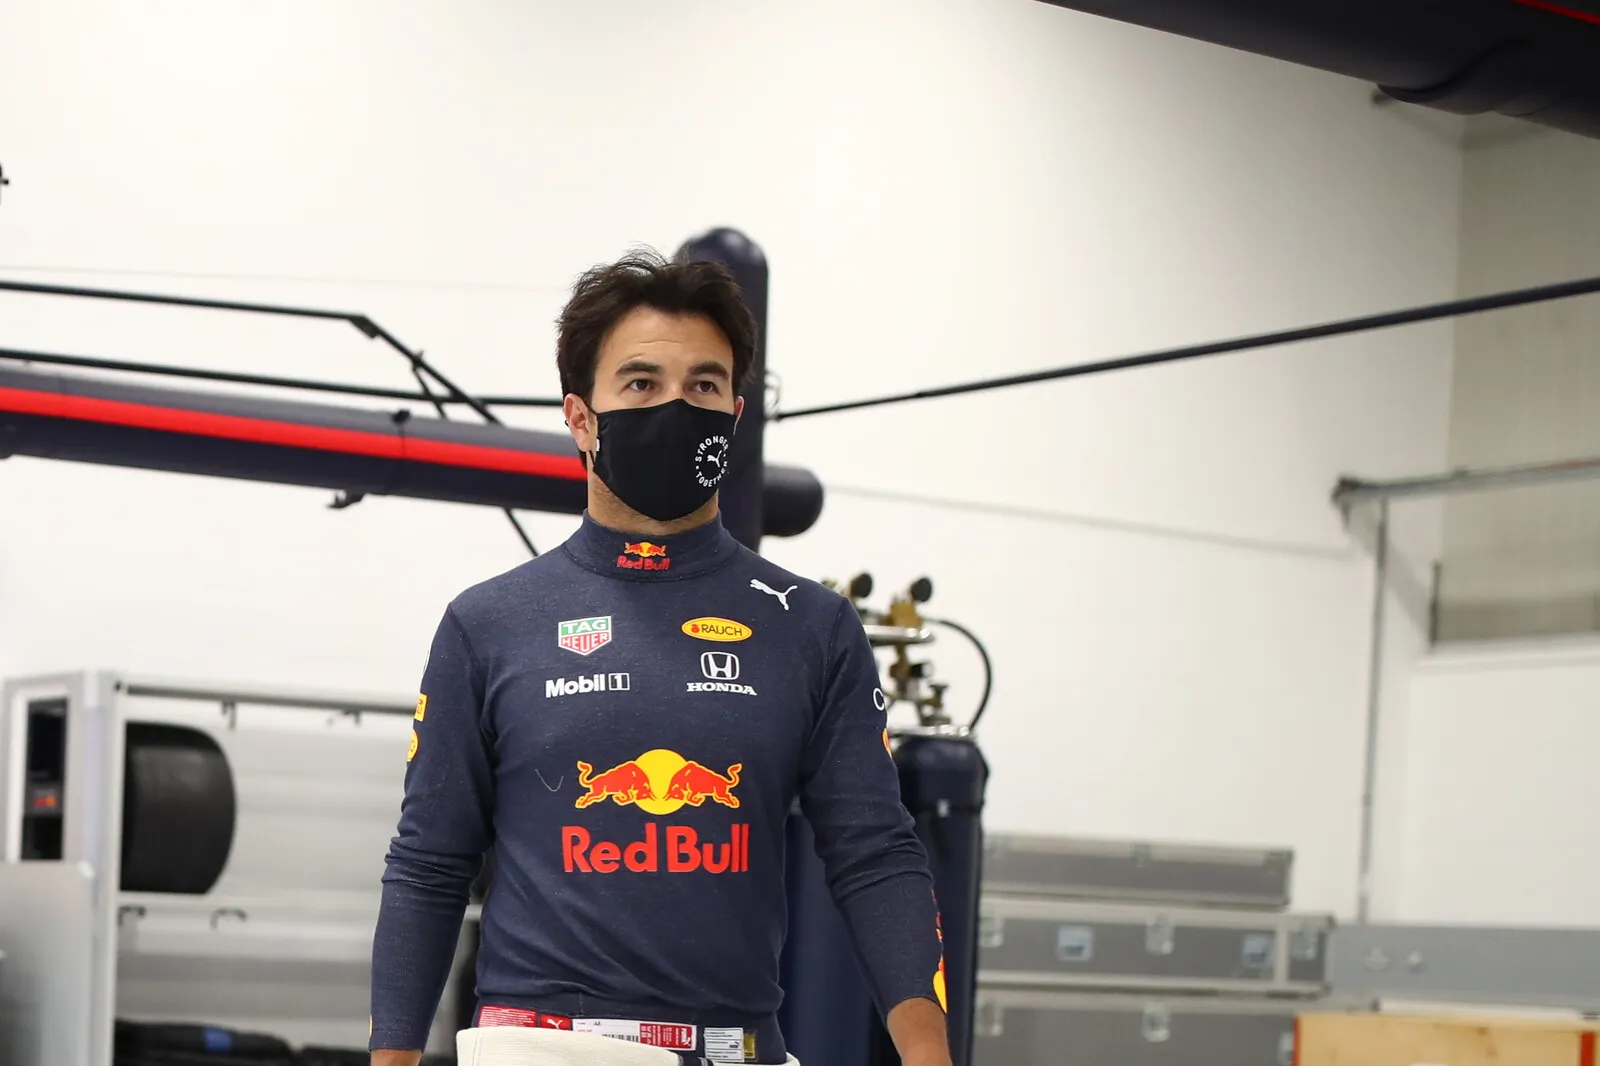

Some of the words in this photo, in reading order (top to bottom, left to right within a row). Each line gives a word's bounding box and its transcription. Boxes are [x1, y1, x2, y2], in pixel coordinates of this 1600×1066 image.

[695, 435, 729, 462] STRONGER
[696, 461, 728, 487] TOGETHER
[617, 555, 644, 570] Red
[643, 557, 670, 570] Bull
[563, 618, 607, 633] TAG
[701, 624, 743, 637] RAUCH
[562, 632, 609, 651] HEUER
[545, 674, 605, 698] Mobil
[609, 673, 626, 691] 1
[686, 681, 758, 696] HONDA
[561, 822, 659, 874] Red
[665, 823, 750, 874] Bull
